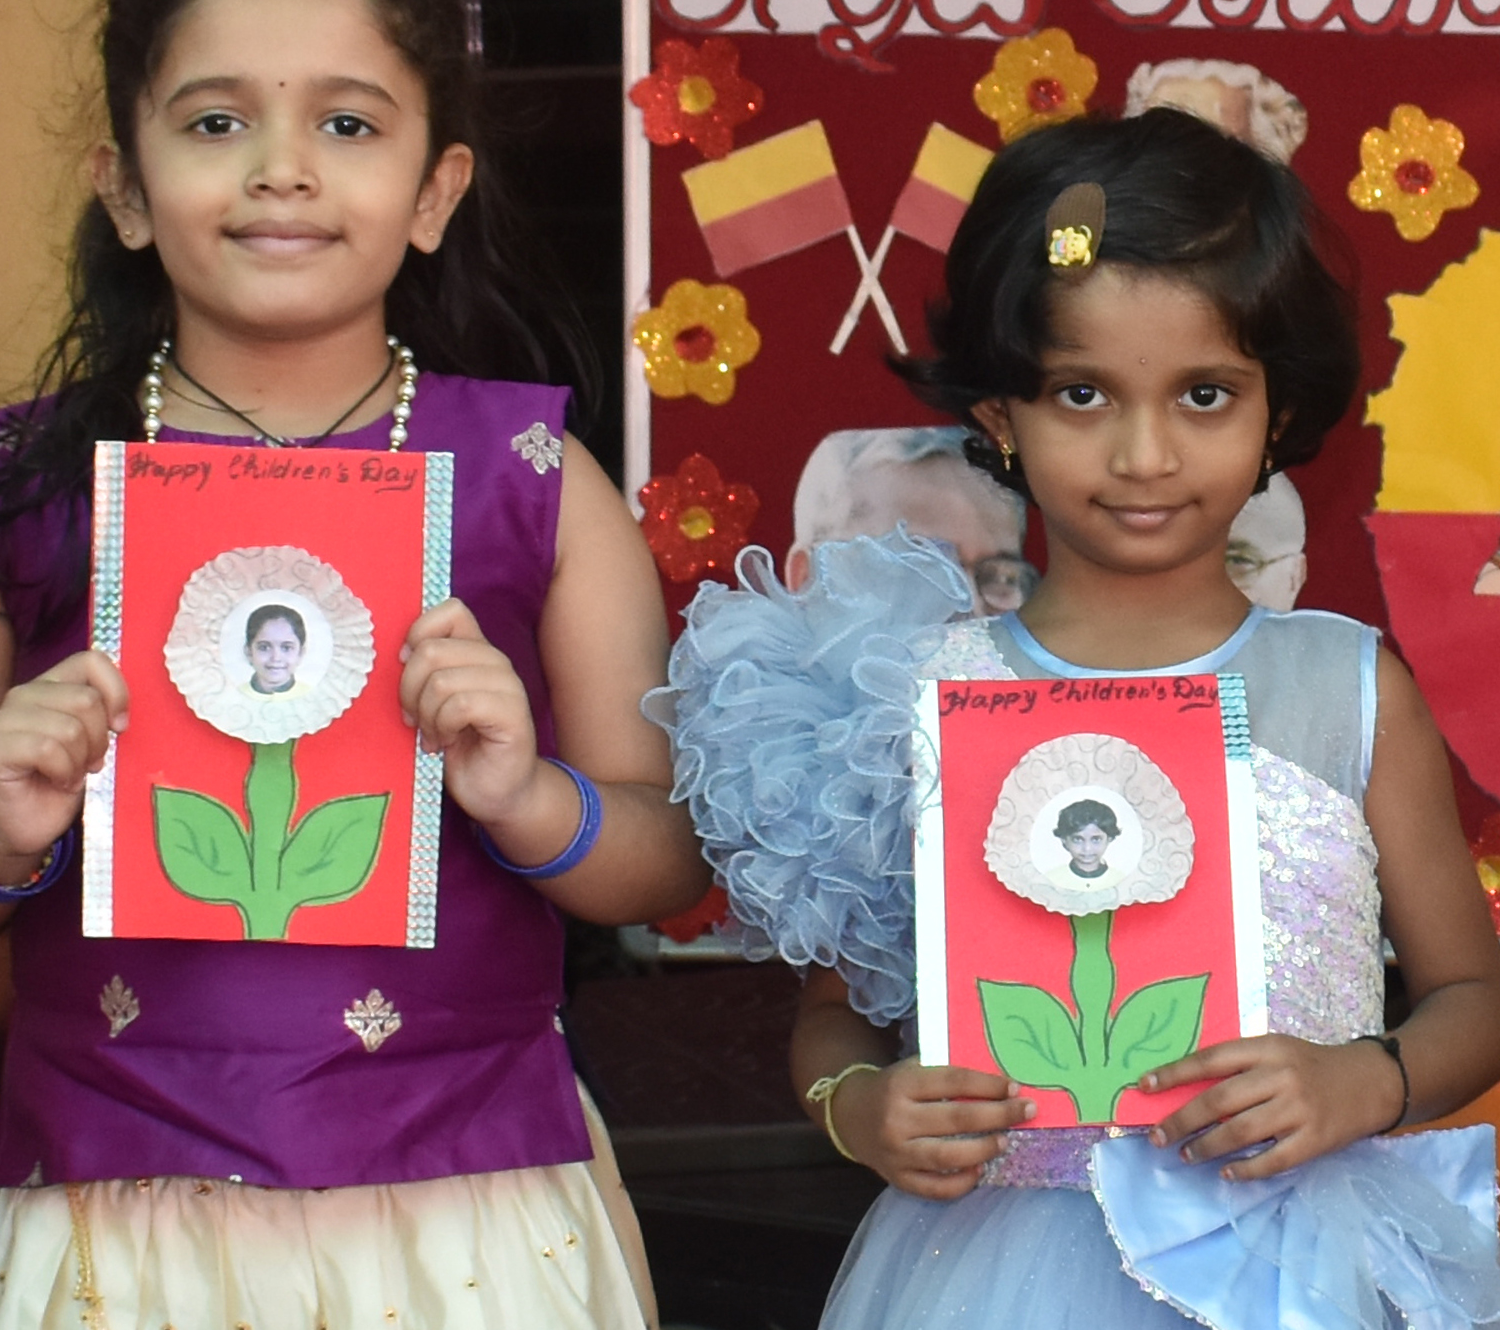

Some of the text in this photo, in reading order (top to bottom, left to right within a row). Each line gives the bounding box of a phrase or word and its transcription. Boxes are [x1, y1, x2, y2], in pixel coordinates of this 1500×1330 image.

[127, 451, 418, 494] Happy Children's Day
[939, 676, 1219, 716] Happy Children's Day
